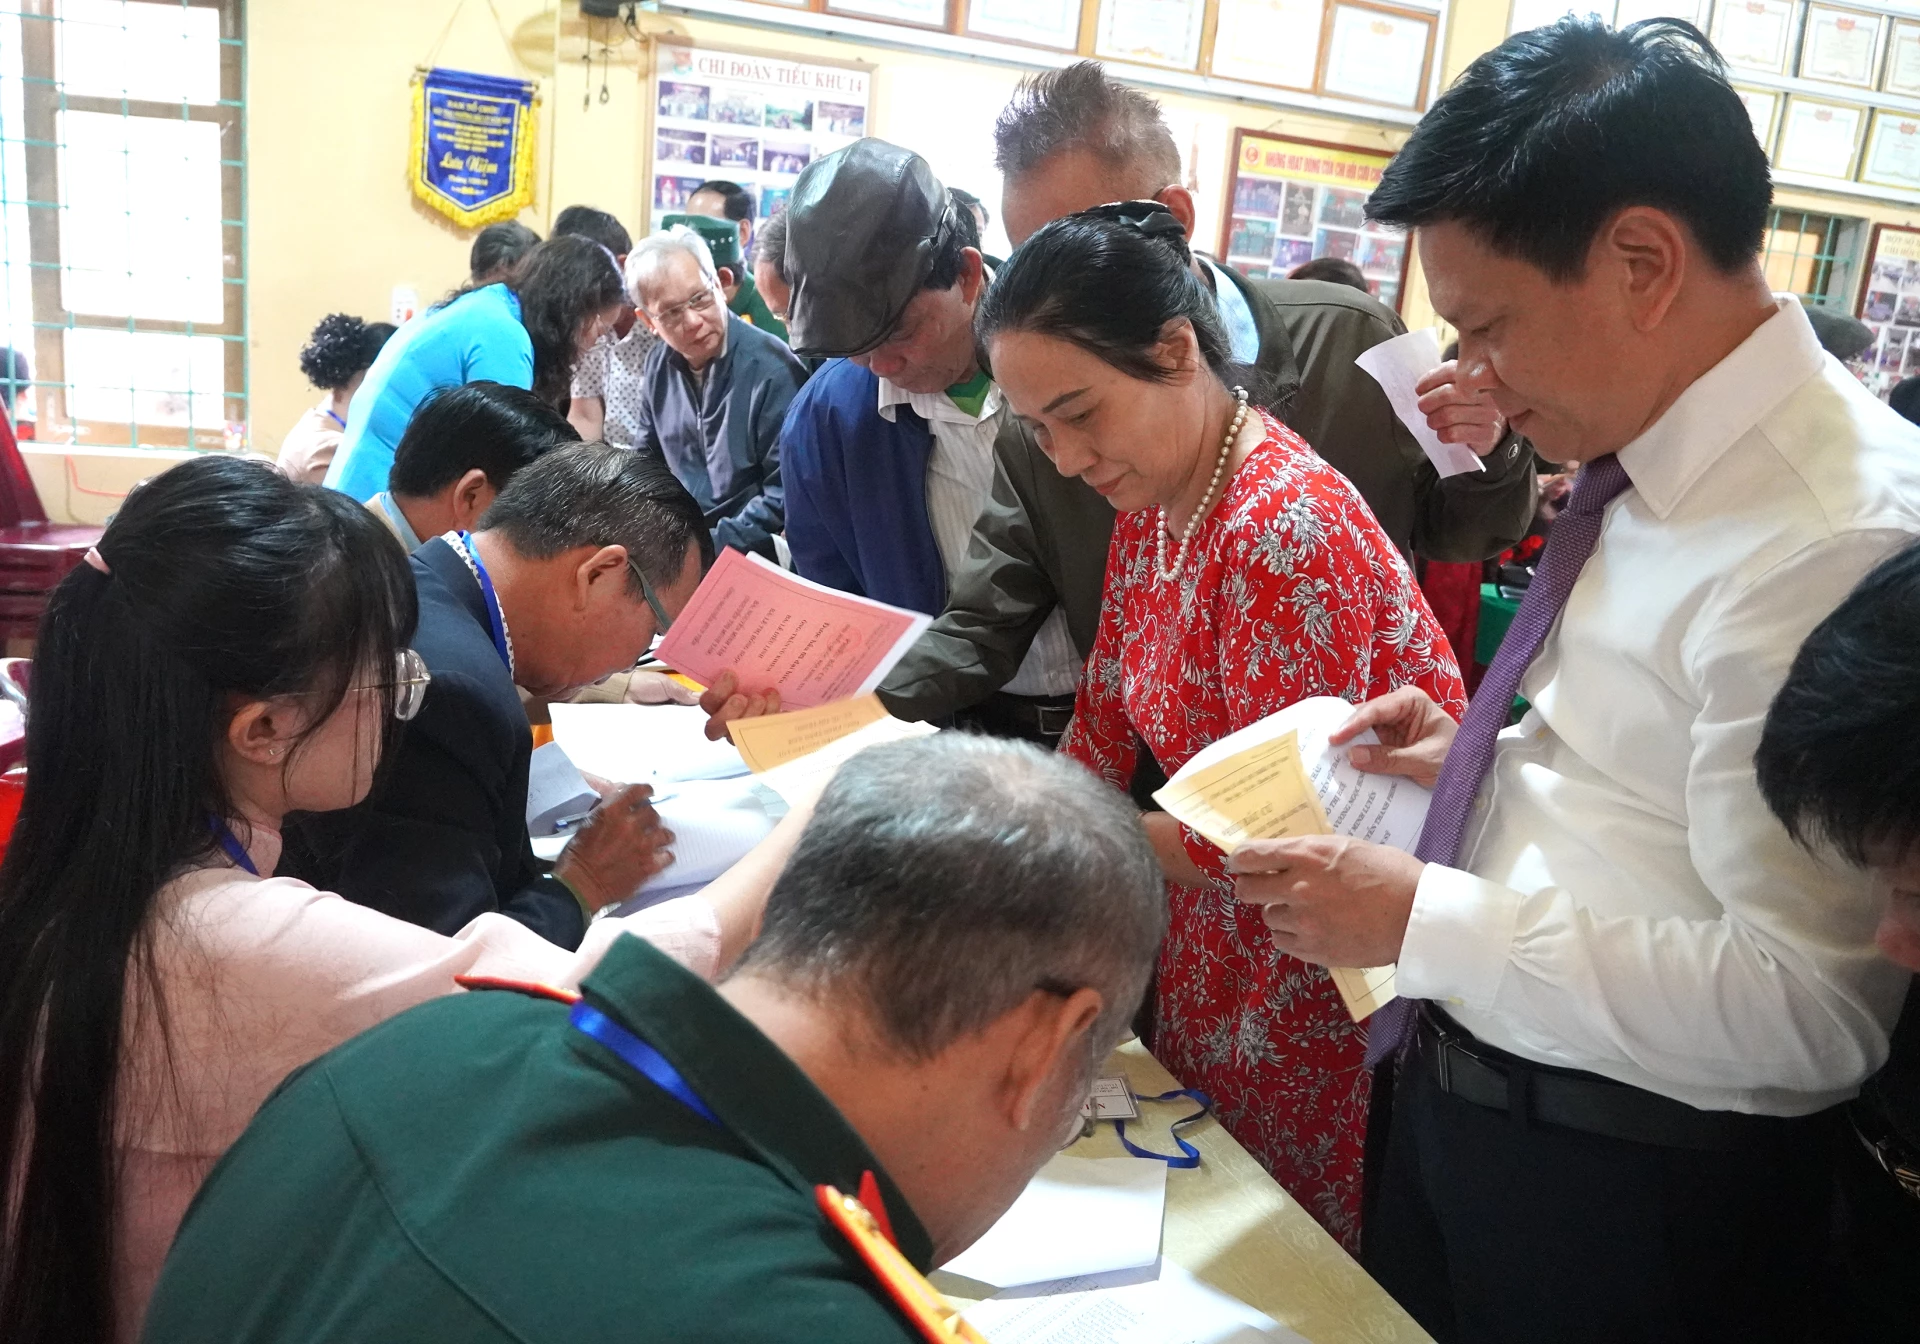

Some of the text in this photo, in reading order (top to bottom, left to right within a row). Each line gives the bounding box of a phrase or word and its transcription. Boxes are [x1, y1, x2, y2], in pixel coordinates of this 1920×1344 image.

[699, 57, 862, 93] CHI ĐOÀN TIỂU KHU 14
[1349, 810, 1366, 833] MINH
